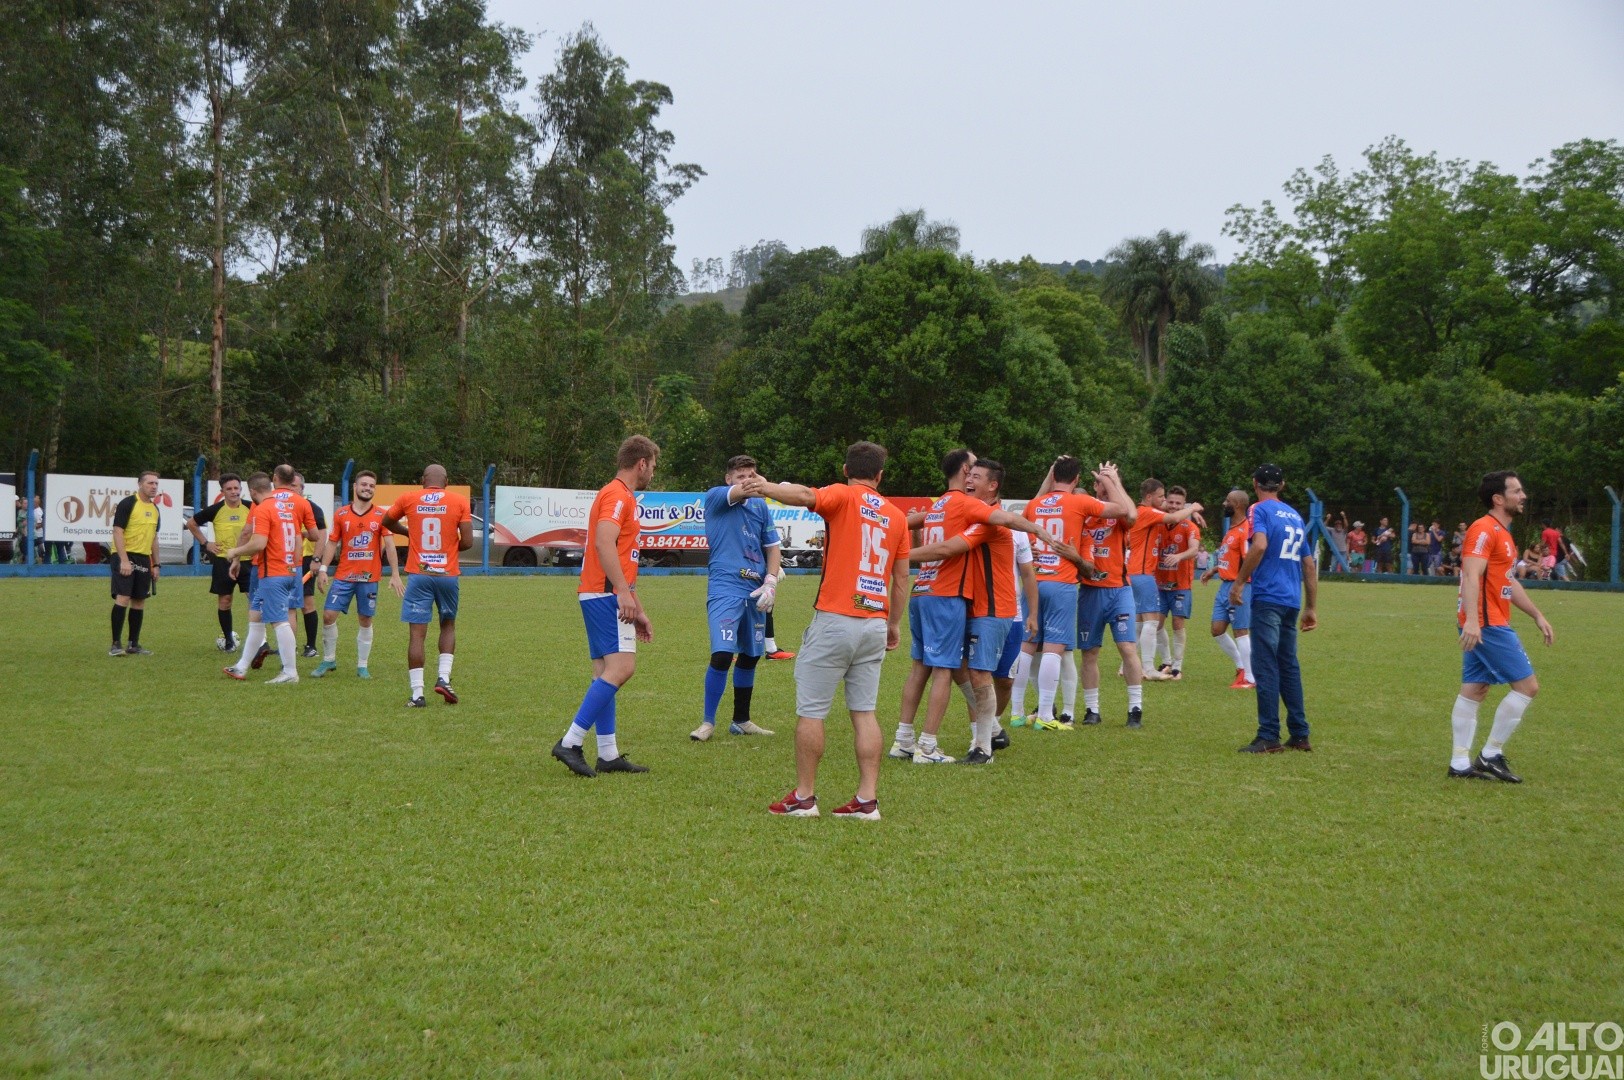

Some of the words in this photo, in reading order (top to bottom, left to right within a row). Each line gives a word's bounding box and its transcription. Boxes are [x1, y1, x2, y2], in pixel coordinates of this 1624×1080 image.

[513, 500, 543, 517] São
[547, 497, 586, 518] Lucas
[638, 505, 665, 520] Dent
[669, 506, 679, 520] &
[63, 526, 93, 535] Respire
[344, 521, 350, 532] 7
[353, 533, 369, 547] LJB
[421, 517, 442, 551] 8
[859, 522, 890, 576] 15
[1279, 525, 1304, 562] 22
[331, 594, 338, 604] 7
[720, 629, 734, 641] 12
